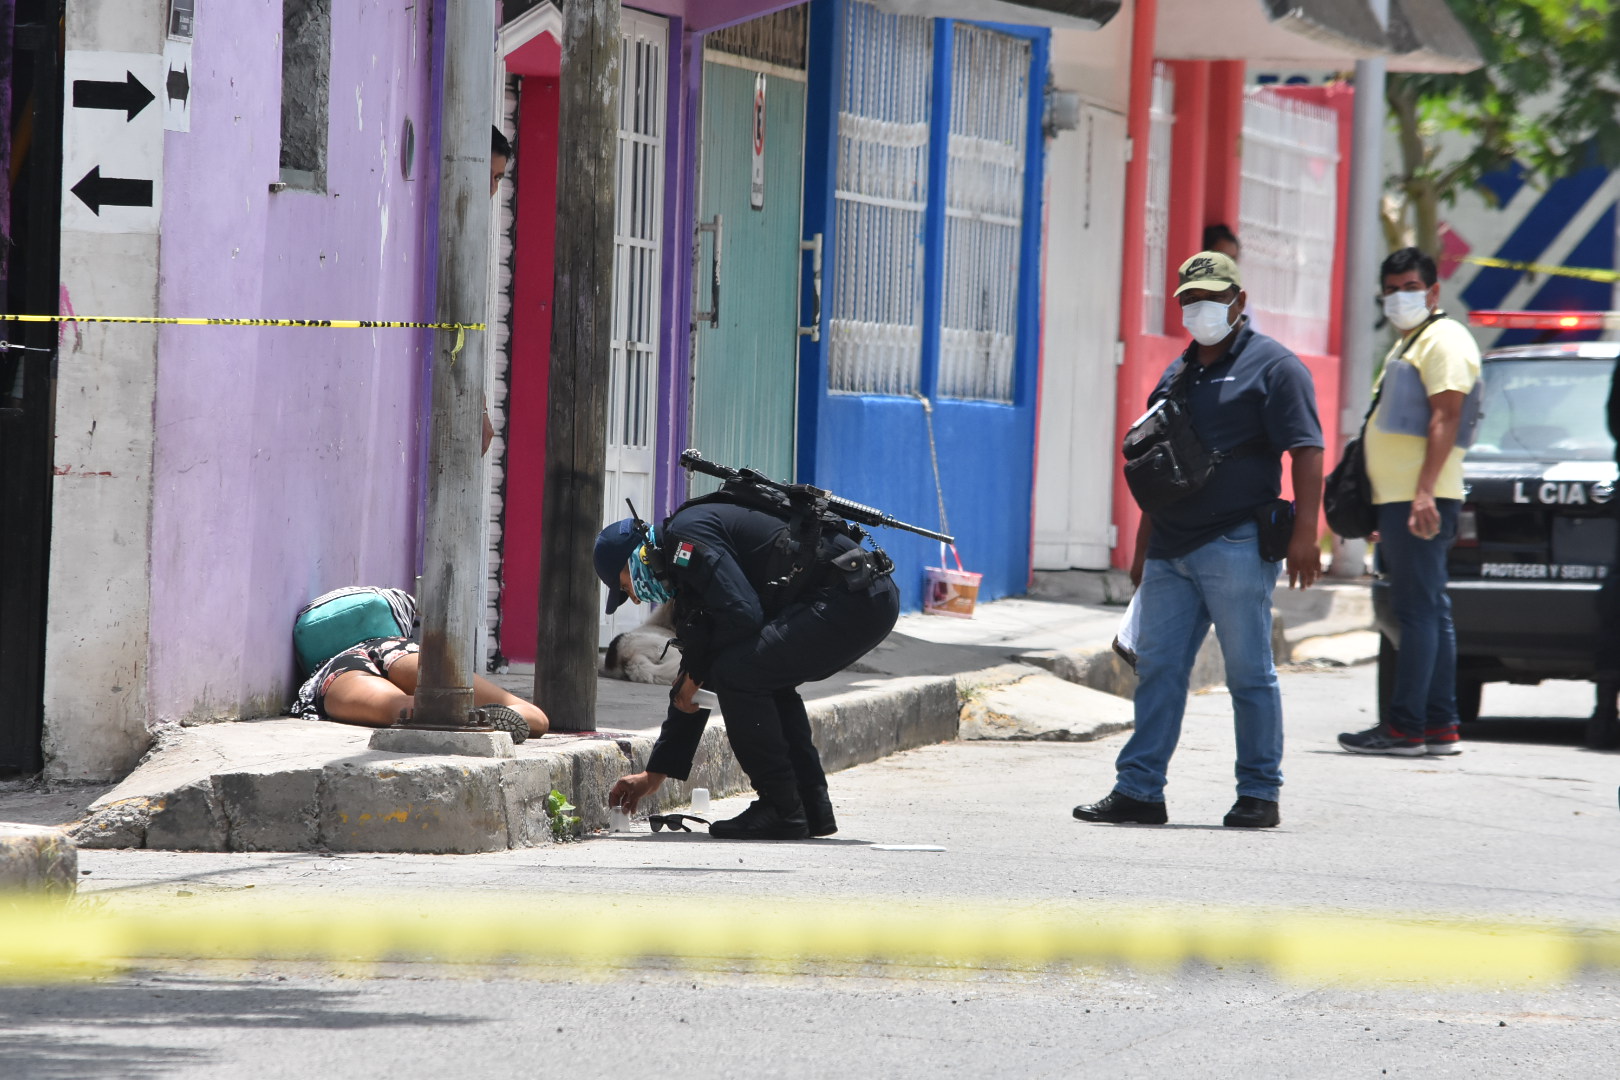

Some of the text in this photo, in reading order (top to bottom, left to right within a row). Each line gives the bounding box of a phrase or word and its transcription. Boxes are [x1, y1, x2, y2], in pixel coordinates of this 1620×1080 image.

[1192, 257, 1212, 268] NIKE
[1481, 563, 1547, 578] PROTEGER
[1549, 564, 1559, 578] Y
